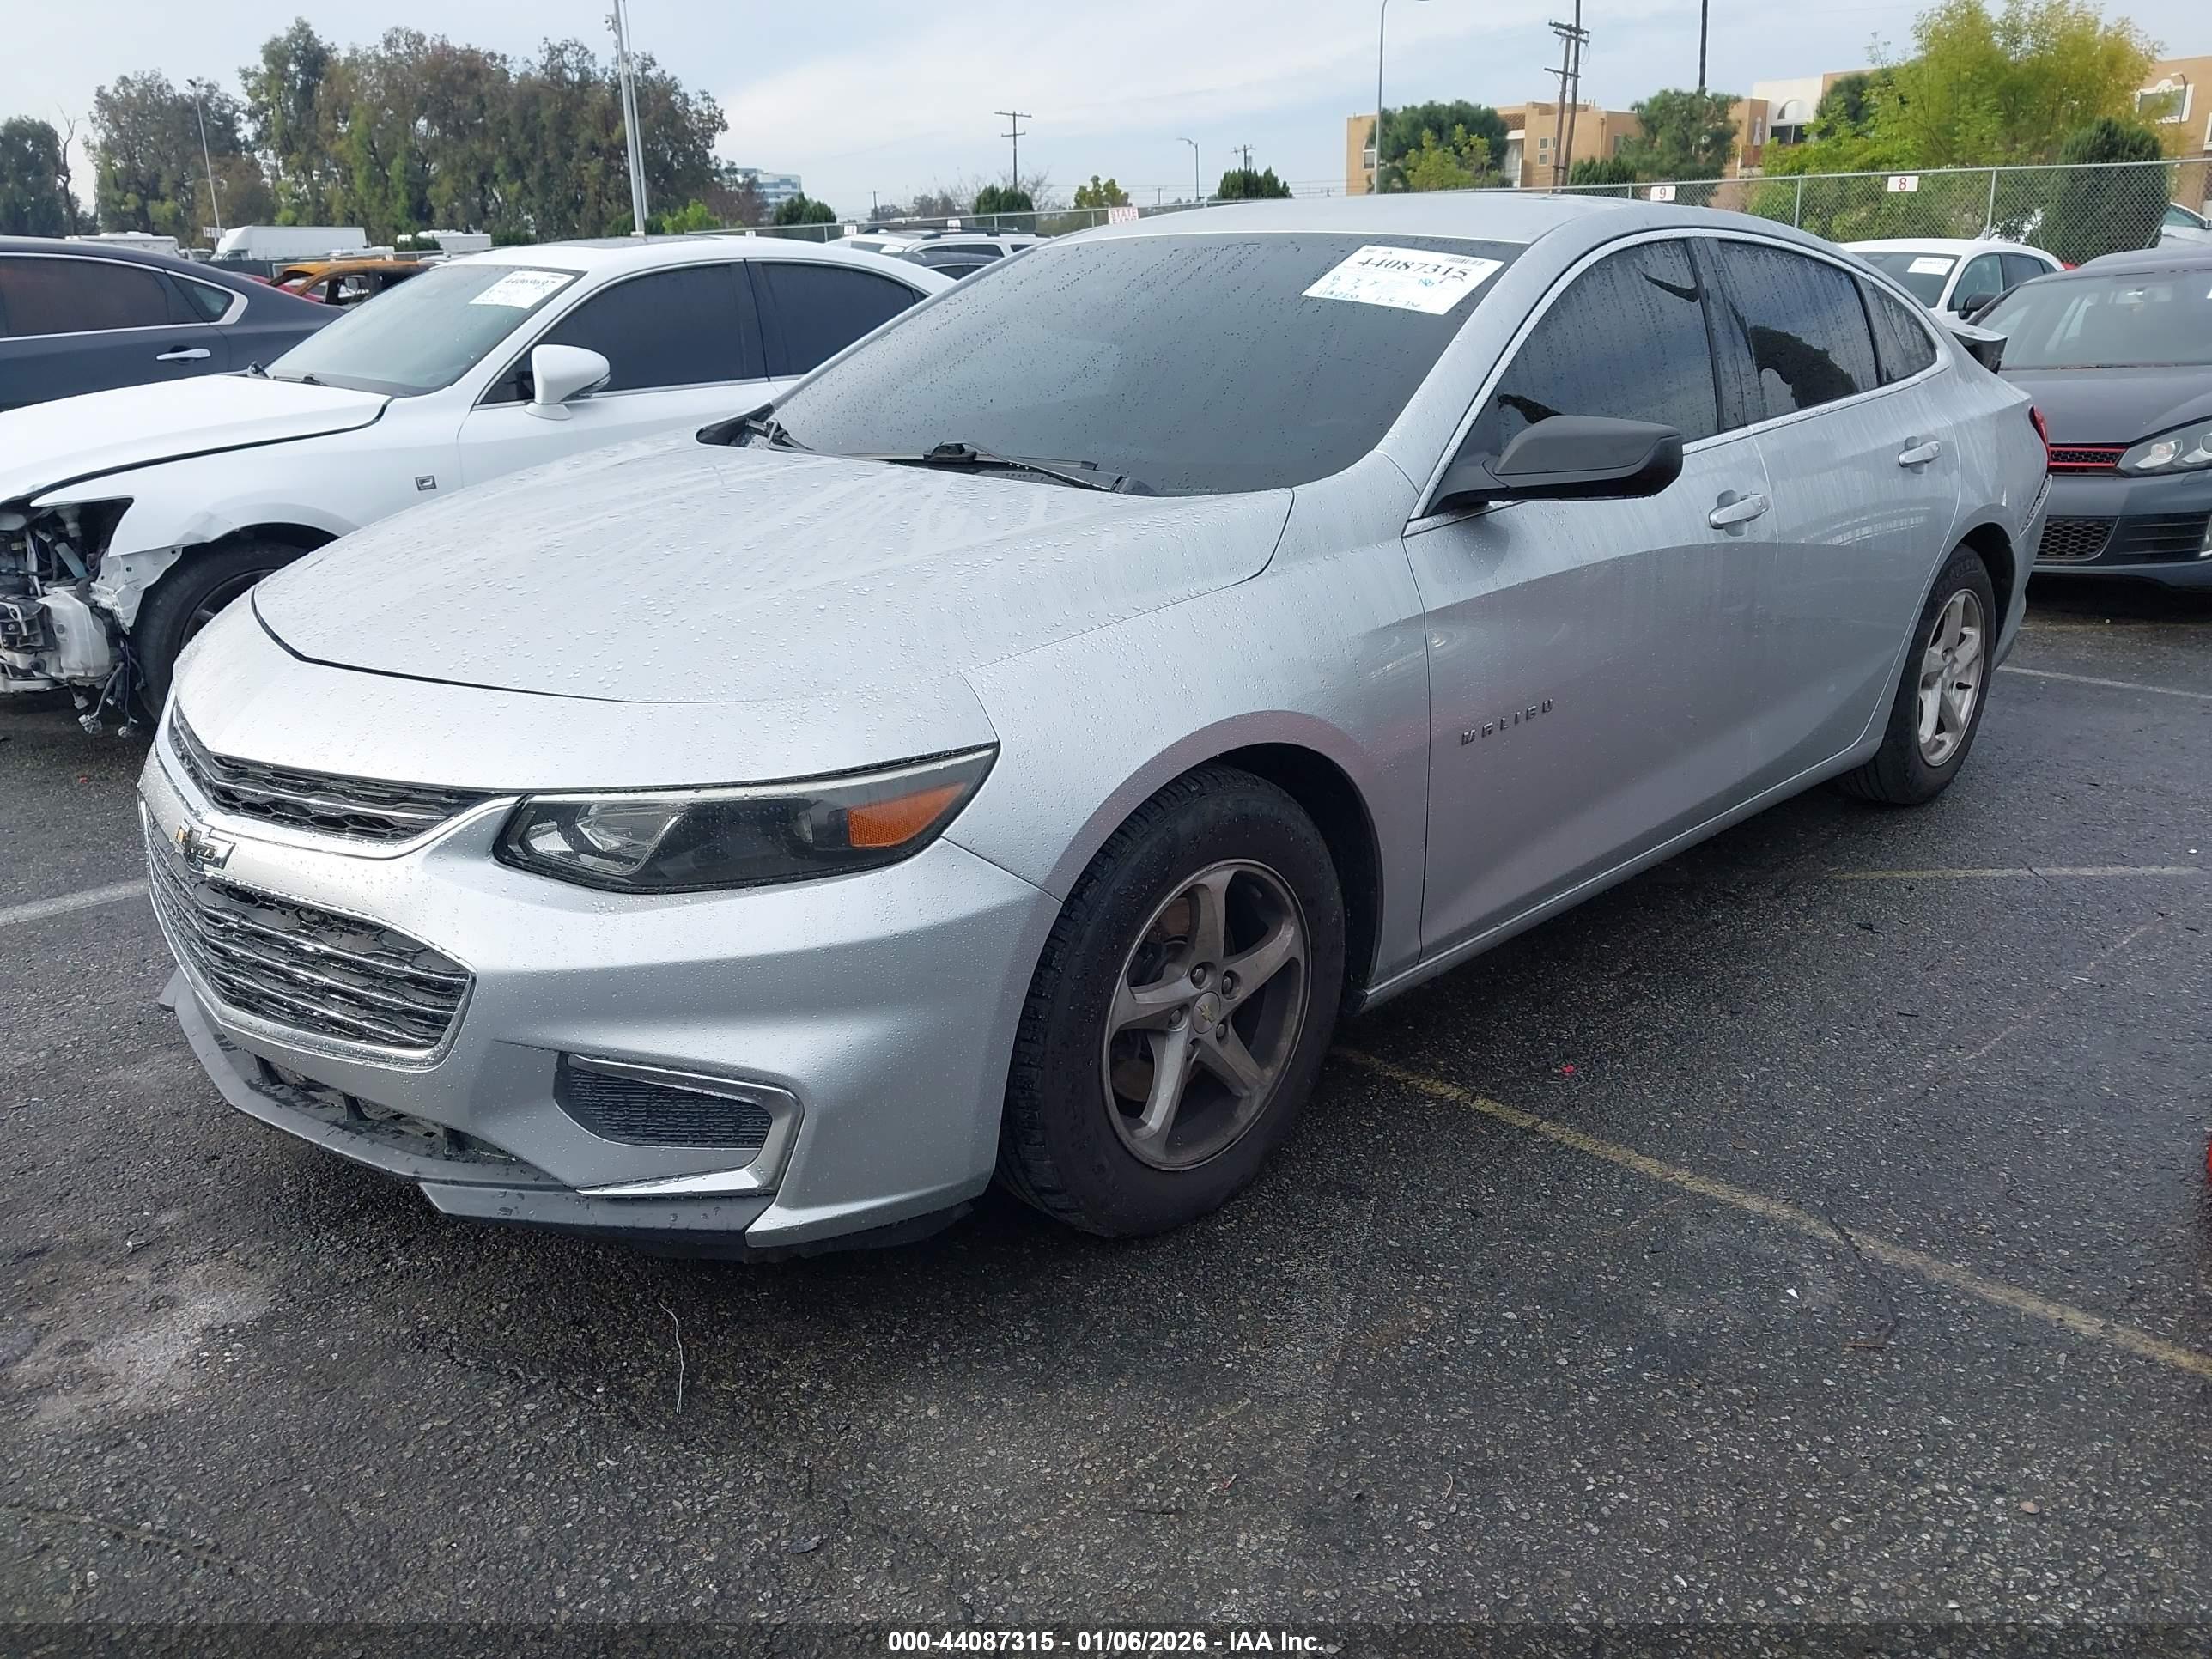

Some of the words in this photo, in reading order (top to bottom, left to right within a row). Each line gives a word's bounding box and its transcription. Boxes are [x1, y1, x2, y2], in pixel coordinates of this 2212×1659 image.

[1899, 177, 1907, 191] 8
[1659, 187, 1667, 199] 9
[1357, 257, 1473, 277] 44087315
[1462, 698, 1553, 746] MALIBU
